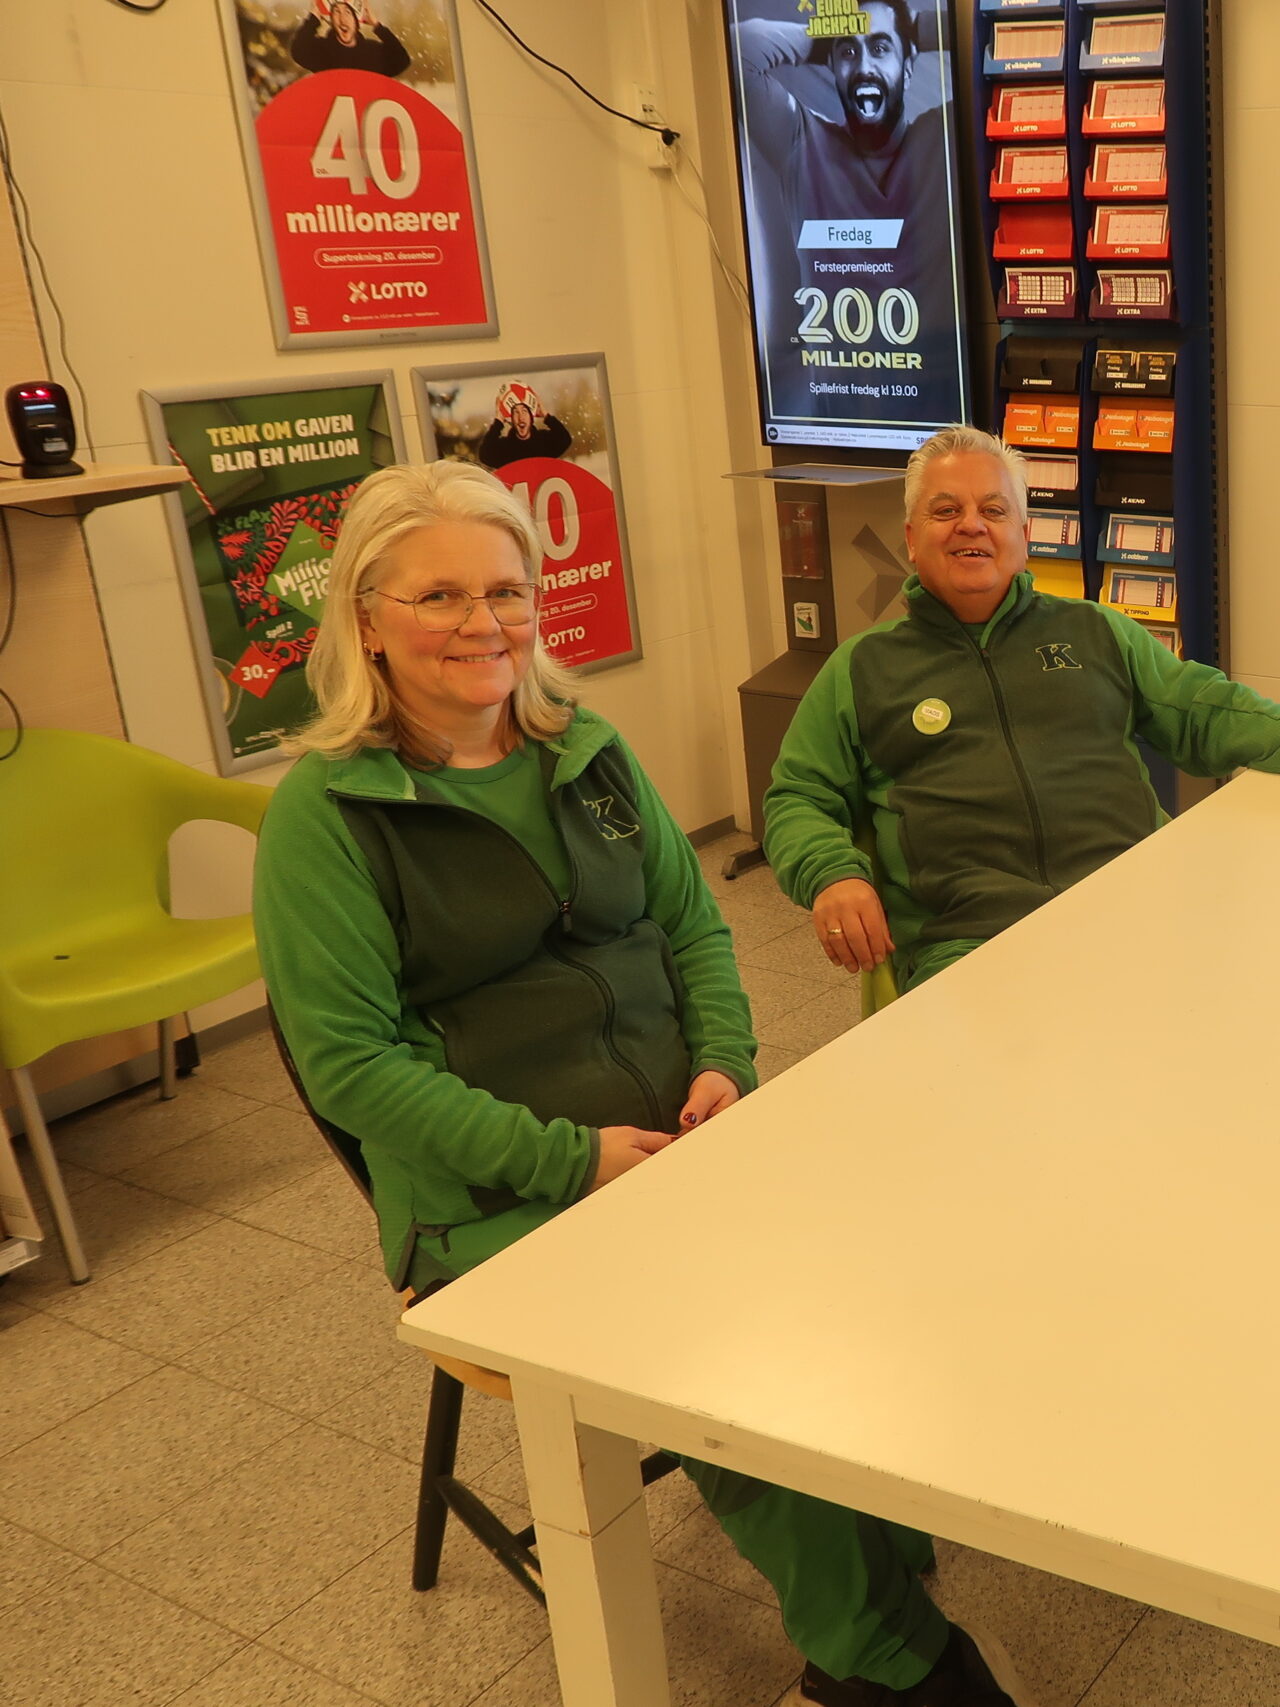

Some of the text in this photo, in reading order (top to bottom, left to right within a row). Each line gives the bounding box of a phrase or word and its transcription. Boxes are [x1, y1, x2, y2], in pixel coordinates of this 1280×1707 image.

[816, 0, 852, 16] EURO
[806, 14, 867, 36] JACKPOT
[310, 96, 421, 200] 40
[286, 204, 460, 234] millionærer
[828, 227, 872, 244] Fredag
[398, 251, 436, 260] desember
[814, 261, 894, 275] Førstepremiepott:
[370, 281, 428, 300] LOTTO
[793, 287, 920, 345] 200
[801, 350, 922, 370] MILLIONER
[809, 382, 918, 397] Spillefrist fredag kl 19.00
[206, 414, 354, 447] TENK OM GAVEN
[210, 438, 360, 473] BLIR EN MILLION
[272, 557, 332, 597] Millio
[1035, 643, 1083, 671] K
[241, 664, 275, 681] 30.-
